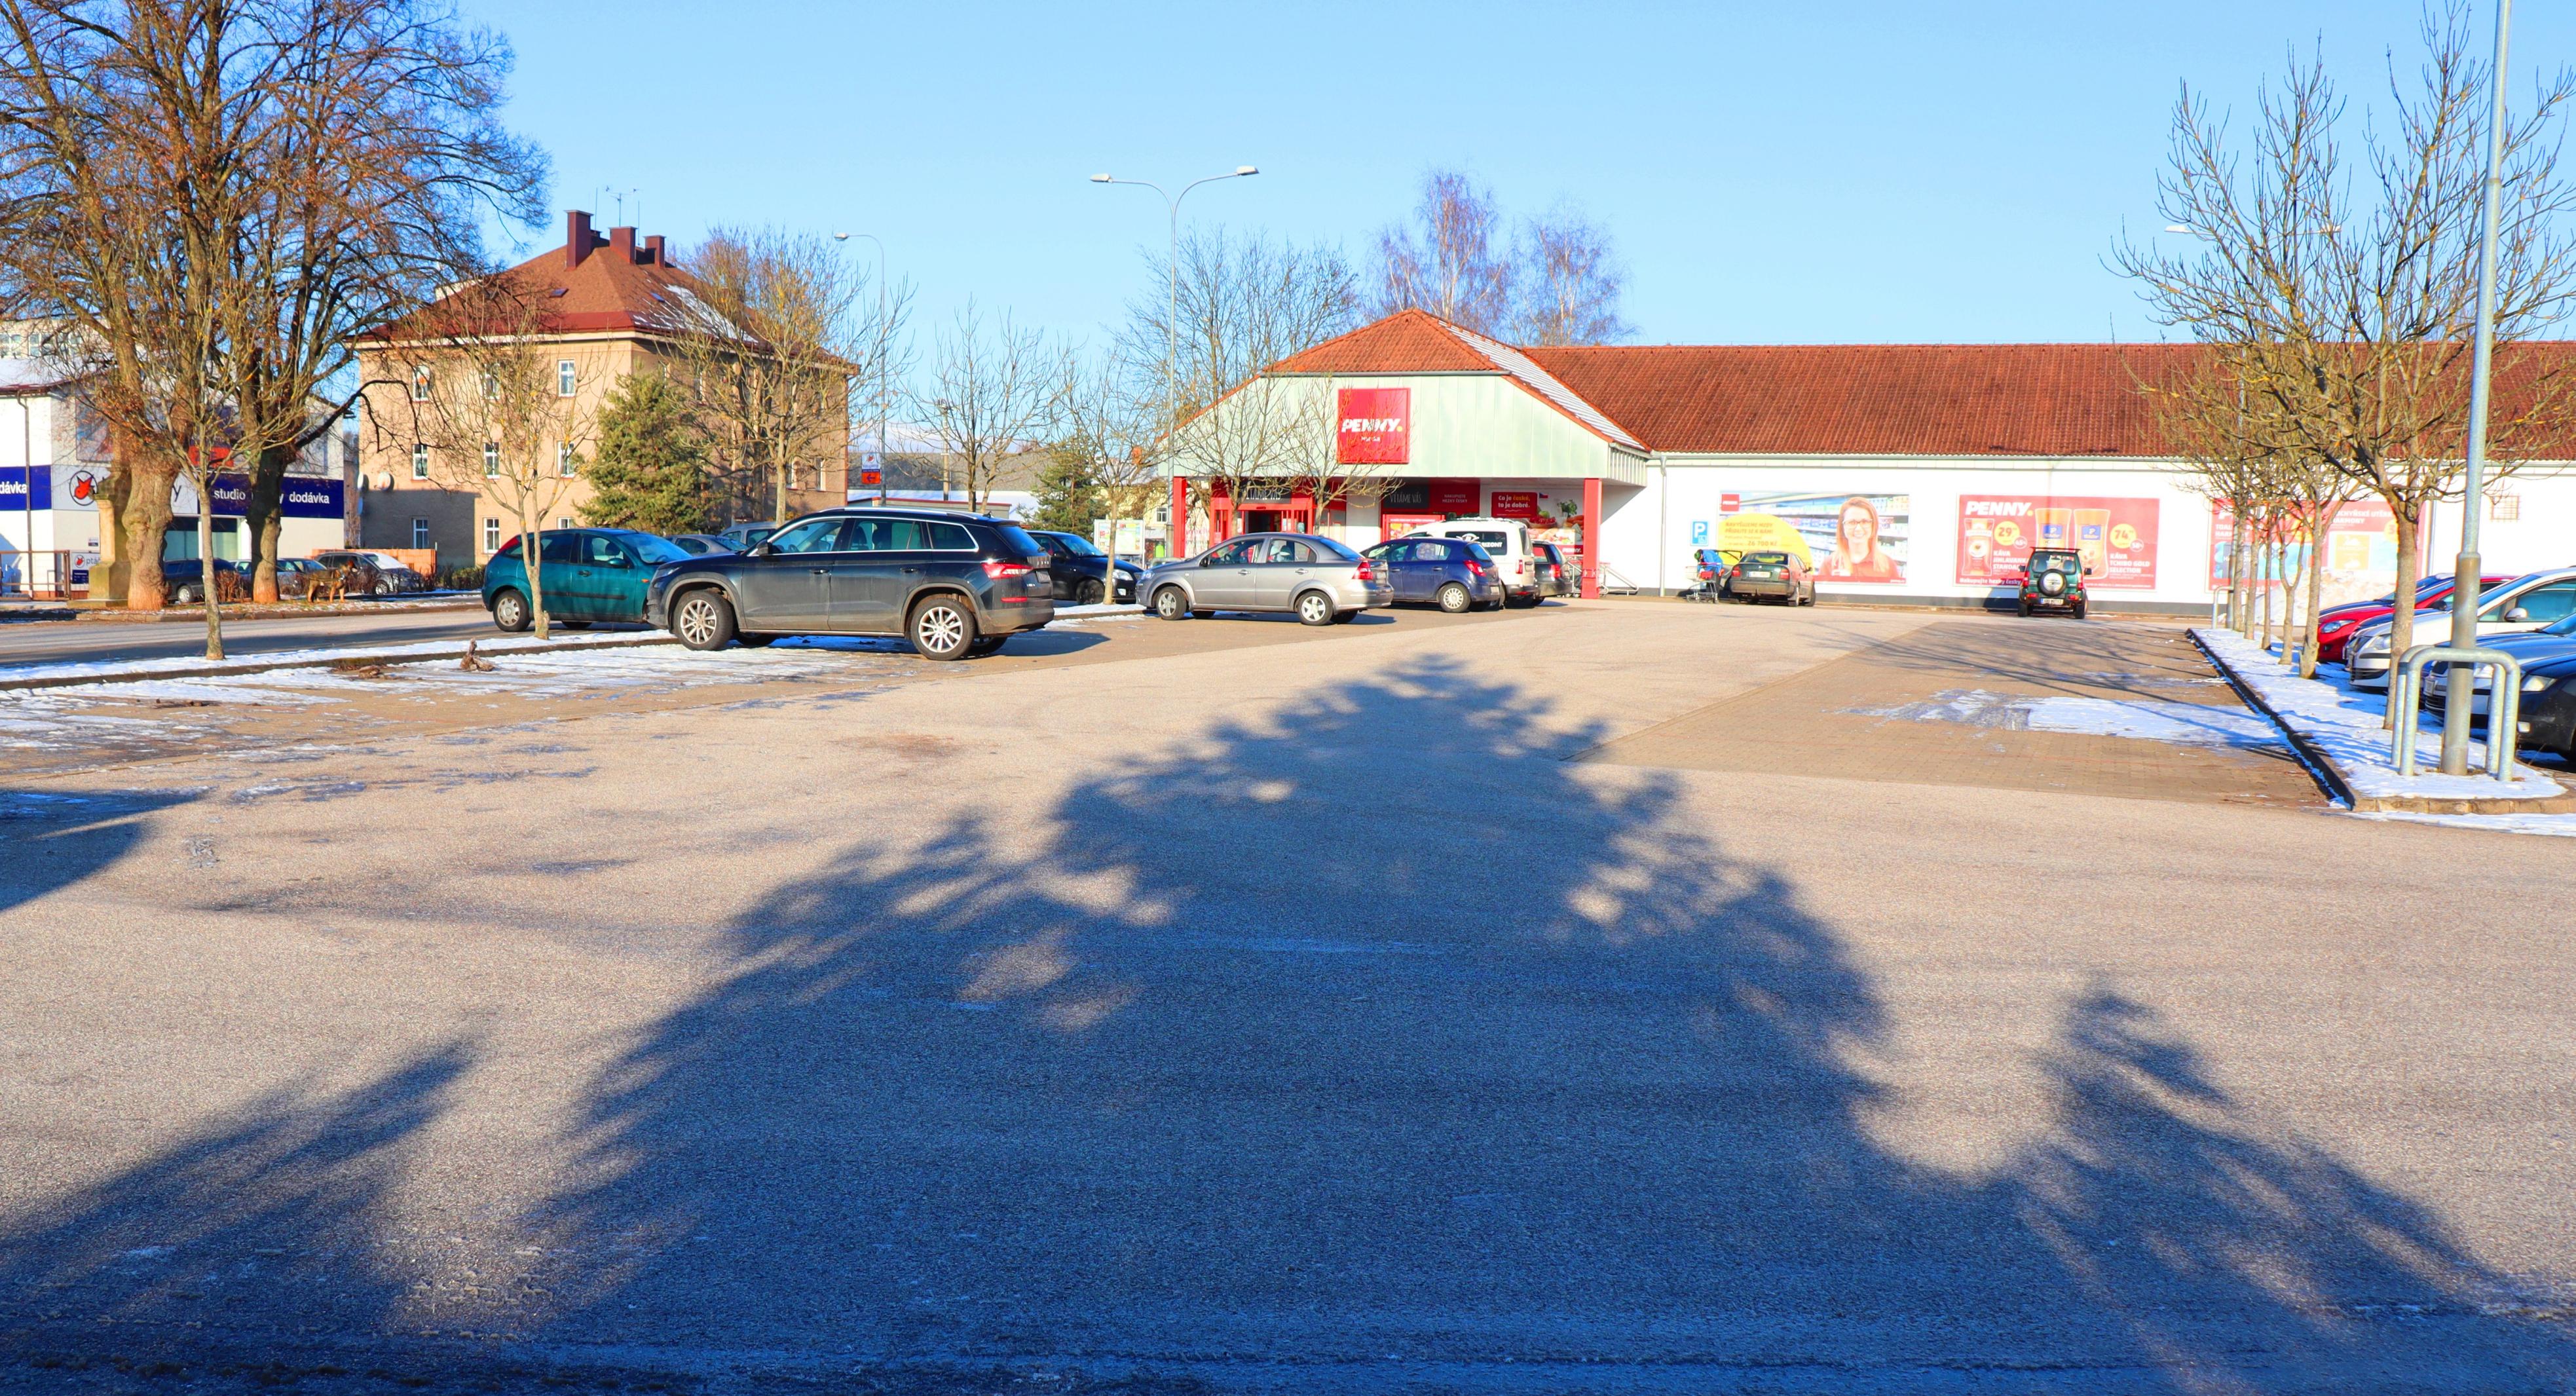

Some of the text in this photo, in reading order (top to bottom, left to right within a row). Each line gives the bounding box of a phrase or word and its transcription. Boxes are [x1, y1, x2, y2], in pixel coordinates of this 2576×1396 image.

[214, 488, 246, 500] studio
[289, 491, 330, 504] dodávka
[1390, 491, 1422, 503] VÍTÁME VÁS
[1965, 500, 2034, 517] PENNY.
[1694, 523, 1705, 538] P
